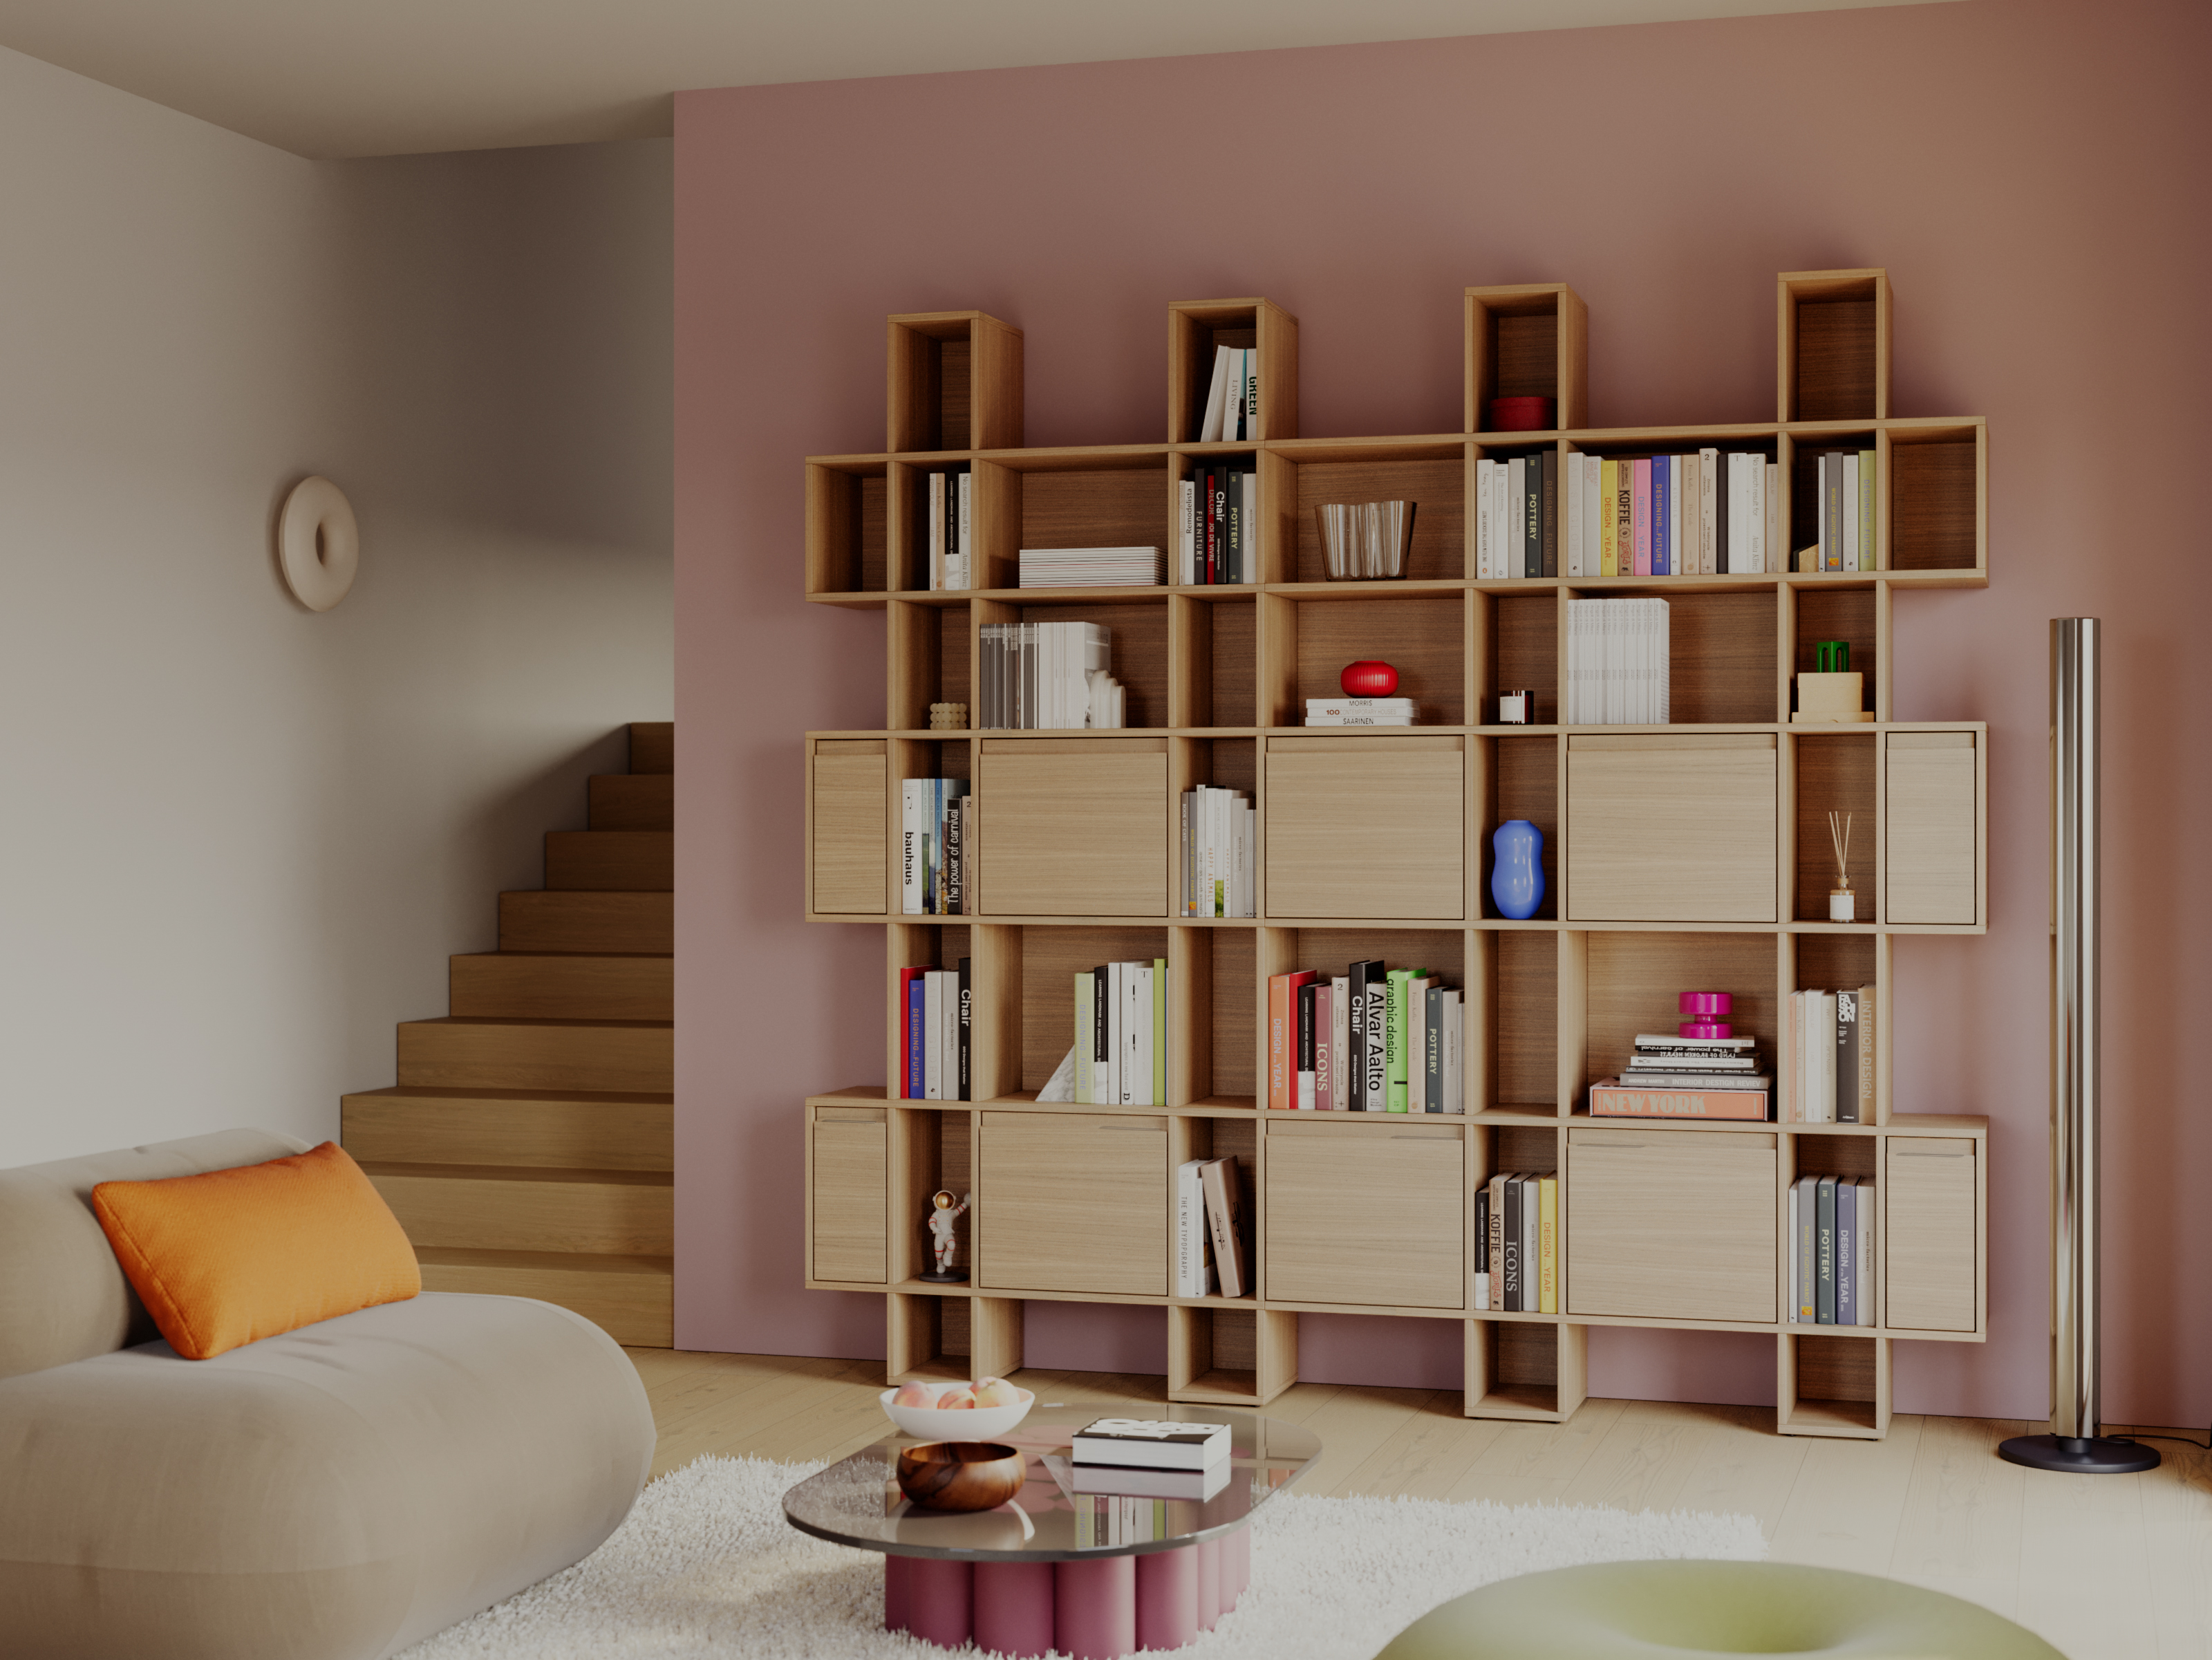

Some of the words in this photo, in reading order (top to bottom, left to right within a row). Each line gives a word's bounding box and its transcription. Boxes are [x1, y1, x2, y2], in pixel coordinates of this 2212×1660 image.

[1753, 457, 1759, 466] No
[963, 476, 968, 485] No
[1217, 491, 1225, 523] Chair
[1619, 490, 1630, 525] KOFFIE
[1209, 534, 1215, 542] DE
[1618, 540, 1631, 565] STORIES
[948, 809, 959, 843] carnival
[906, 832, 914, 885] bauhaus
[947, 845, 959, 856] of
[950, 859, 962, 885] power
[948, 886, 959, 904] The
[961, 989, 971, 1027] Chair
[1352, 996, 1362, 1034] Chair
[1369, 991, 1384, 1039] Alvar
[1387, 978, 1397, 1023] graphic
[1387, 1025, 1397, 1063] design
[1863, 1000, 1871, 1053] INTERIOR
[1317, 1043, 1327, 1091] ICONS
[1369, 1045, 1384, 1091] Aalto
[1863, 1057, 1871, 1099] DESIGN
[1603, 1093, 1649, 1112] NEW
[1648, 1094, 1706, 1114] YORK
[1490, 1213, 1500, 1253] KOFFIE
[1490, 1270, 1501, 1298] STORIES
[1506, 1241, 1517, 1291] ICONS
